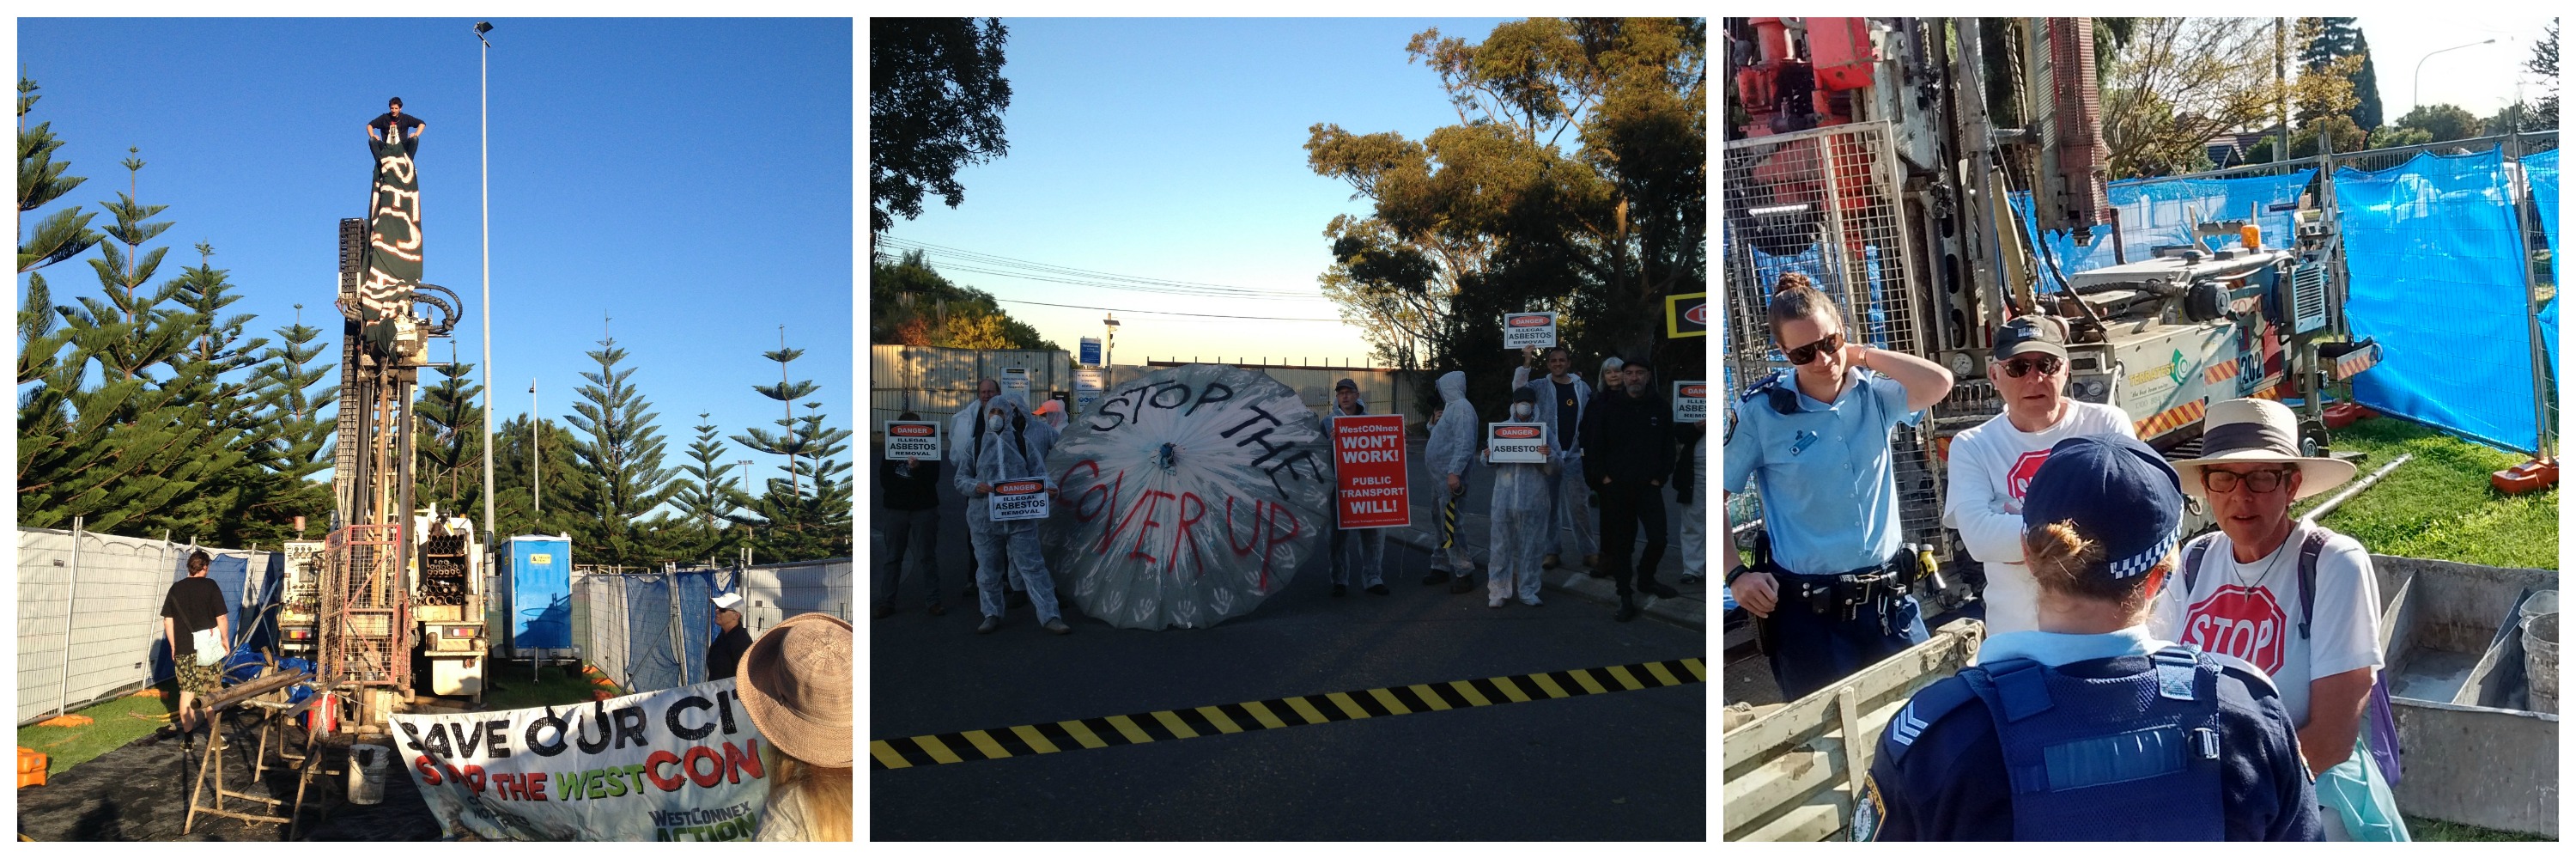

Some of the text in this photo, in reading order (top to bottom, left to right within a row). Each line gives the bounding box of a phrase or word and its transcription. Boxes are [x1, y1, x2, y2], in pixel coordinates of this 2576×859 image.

[2129, 362, 2176, 387] TERRATEST
[2240, 351, 2263, 384] 202
[1091, 380, 1324, 500] STOP THE
[1340, 424, 1399, 433] WestCONnex
[1341, 435, 1397, 449] WON'T
[1342, 449, 1399, 463] WORK!
[1340, 487, 1405, 497] TRANSPORT
[1352, 476, 1391, 485] PUBLIC
[996, 499, 1045, 510] ASBESTOS
[1350, 500, 1398, 515] WILL!
[1058, 459, 1300, 592] COVER UP
[2191, 613, 2275, 665] STOP
[401, 689, 740, 759] SAVE OUR CI
[415, 755, 486, 799] SP
[491, 772, 548, 801] THE
[657, 812, 758, 842] ACTION
